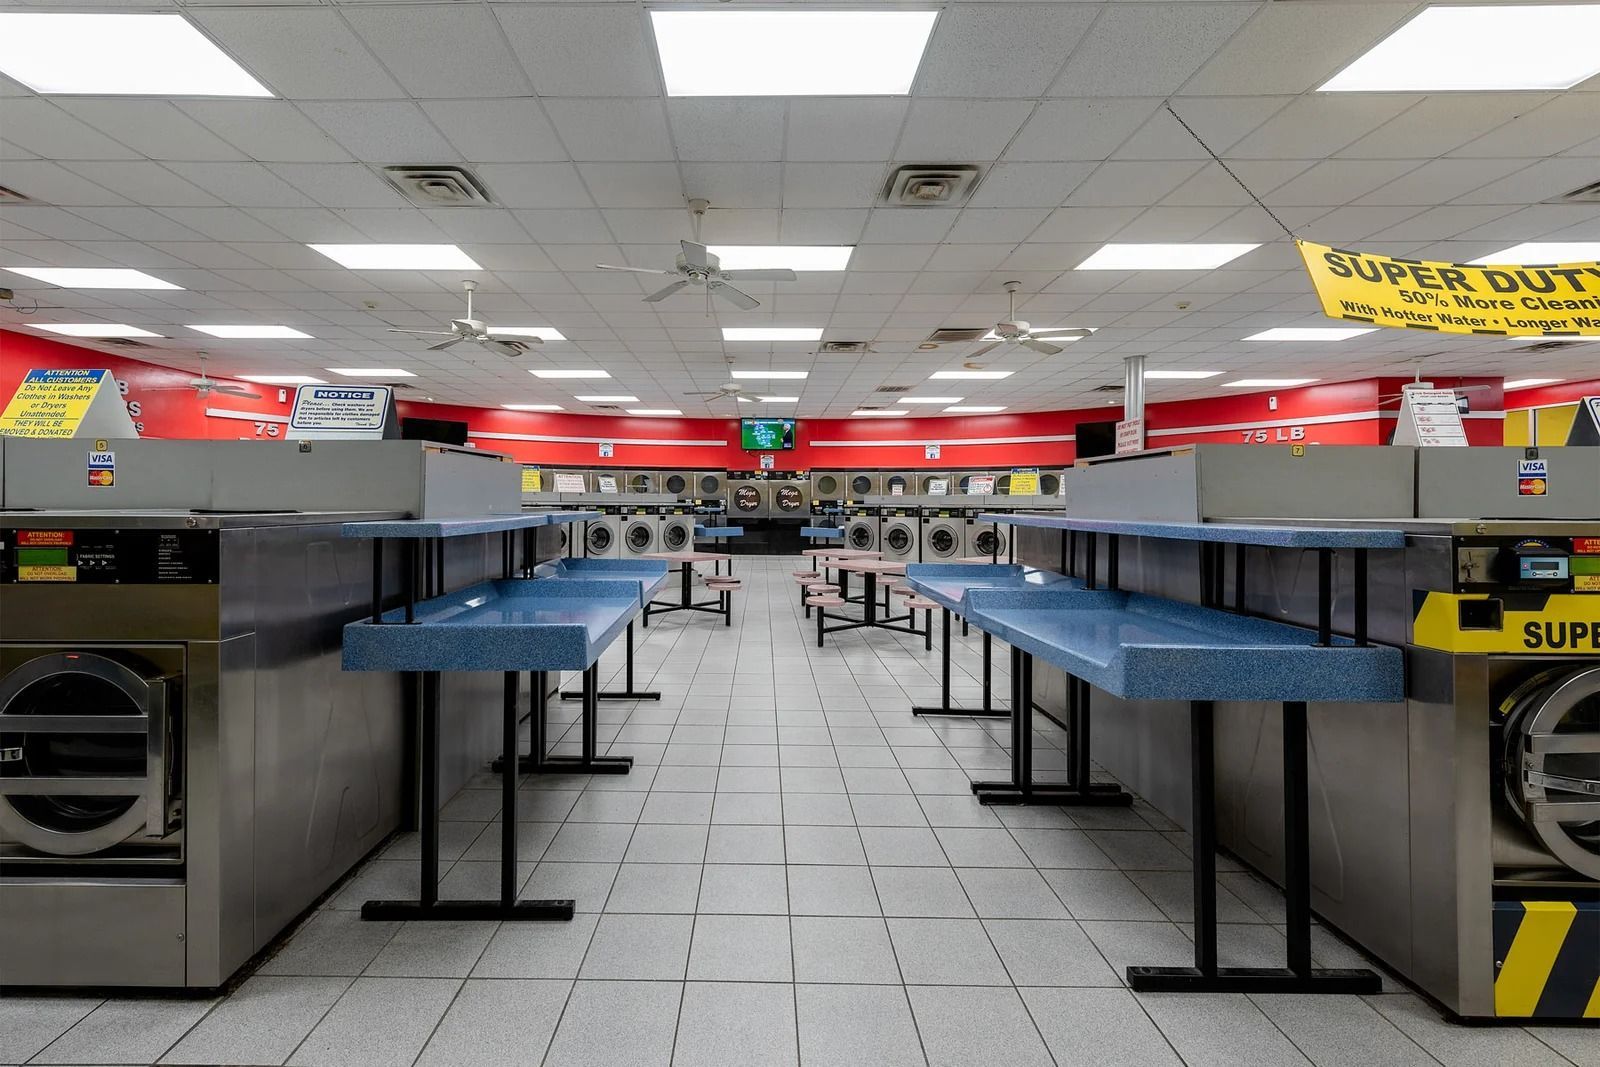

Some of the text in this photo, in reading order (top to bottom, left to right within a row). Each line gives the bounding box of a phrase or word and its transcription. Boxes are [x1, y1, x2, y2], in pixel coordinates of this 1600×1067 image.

[1323, 252, 1478, 292] SUPER
[1398, 289, 1600, 311] 50% More Cleani
[1339, 300, 1377, 316] With
[1383, 307, 1433, 323] Hotter
[1438, 312, 1487, 327] Water
[1507, 315, 1569, 331] Longer
[76, 385, 93, 393] Any
[317, 391, 372, 399] NOTICE
[41, 402, 67, 410] Dryers
[254, 422, 279, 437] 75
[1242, 427, 1305, 444] 75 LB
[92, 454, 113, 463] VISA
[1522, 462, 1545, 471] VISA
[738, 489, 756, 497] Mega
[780, 489, 798, 497] Mega
[1524, 621, 1600, 649] SUPE
